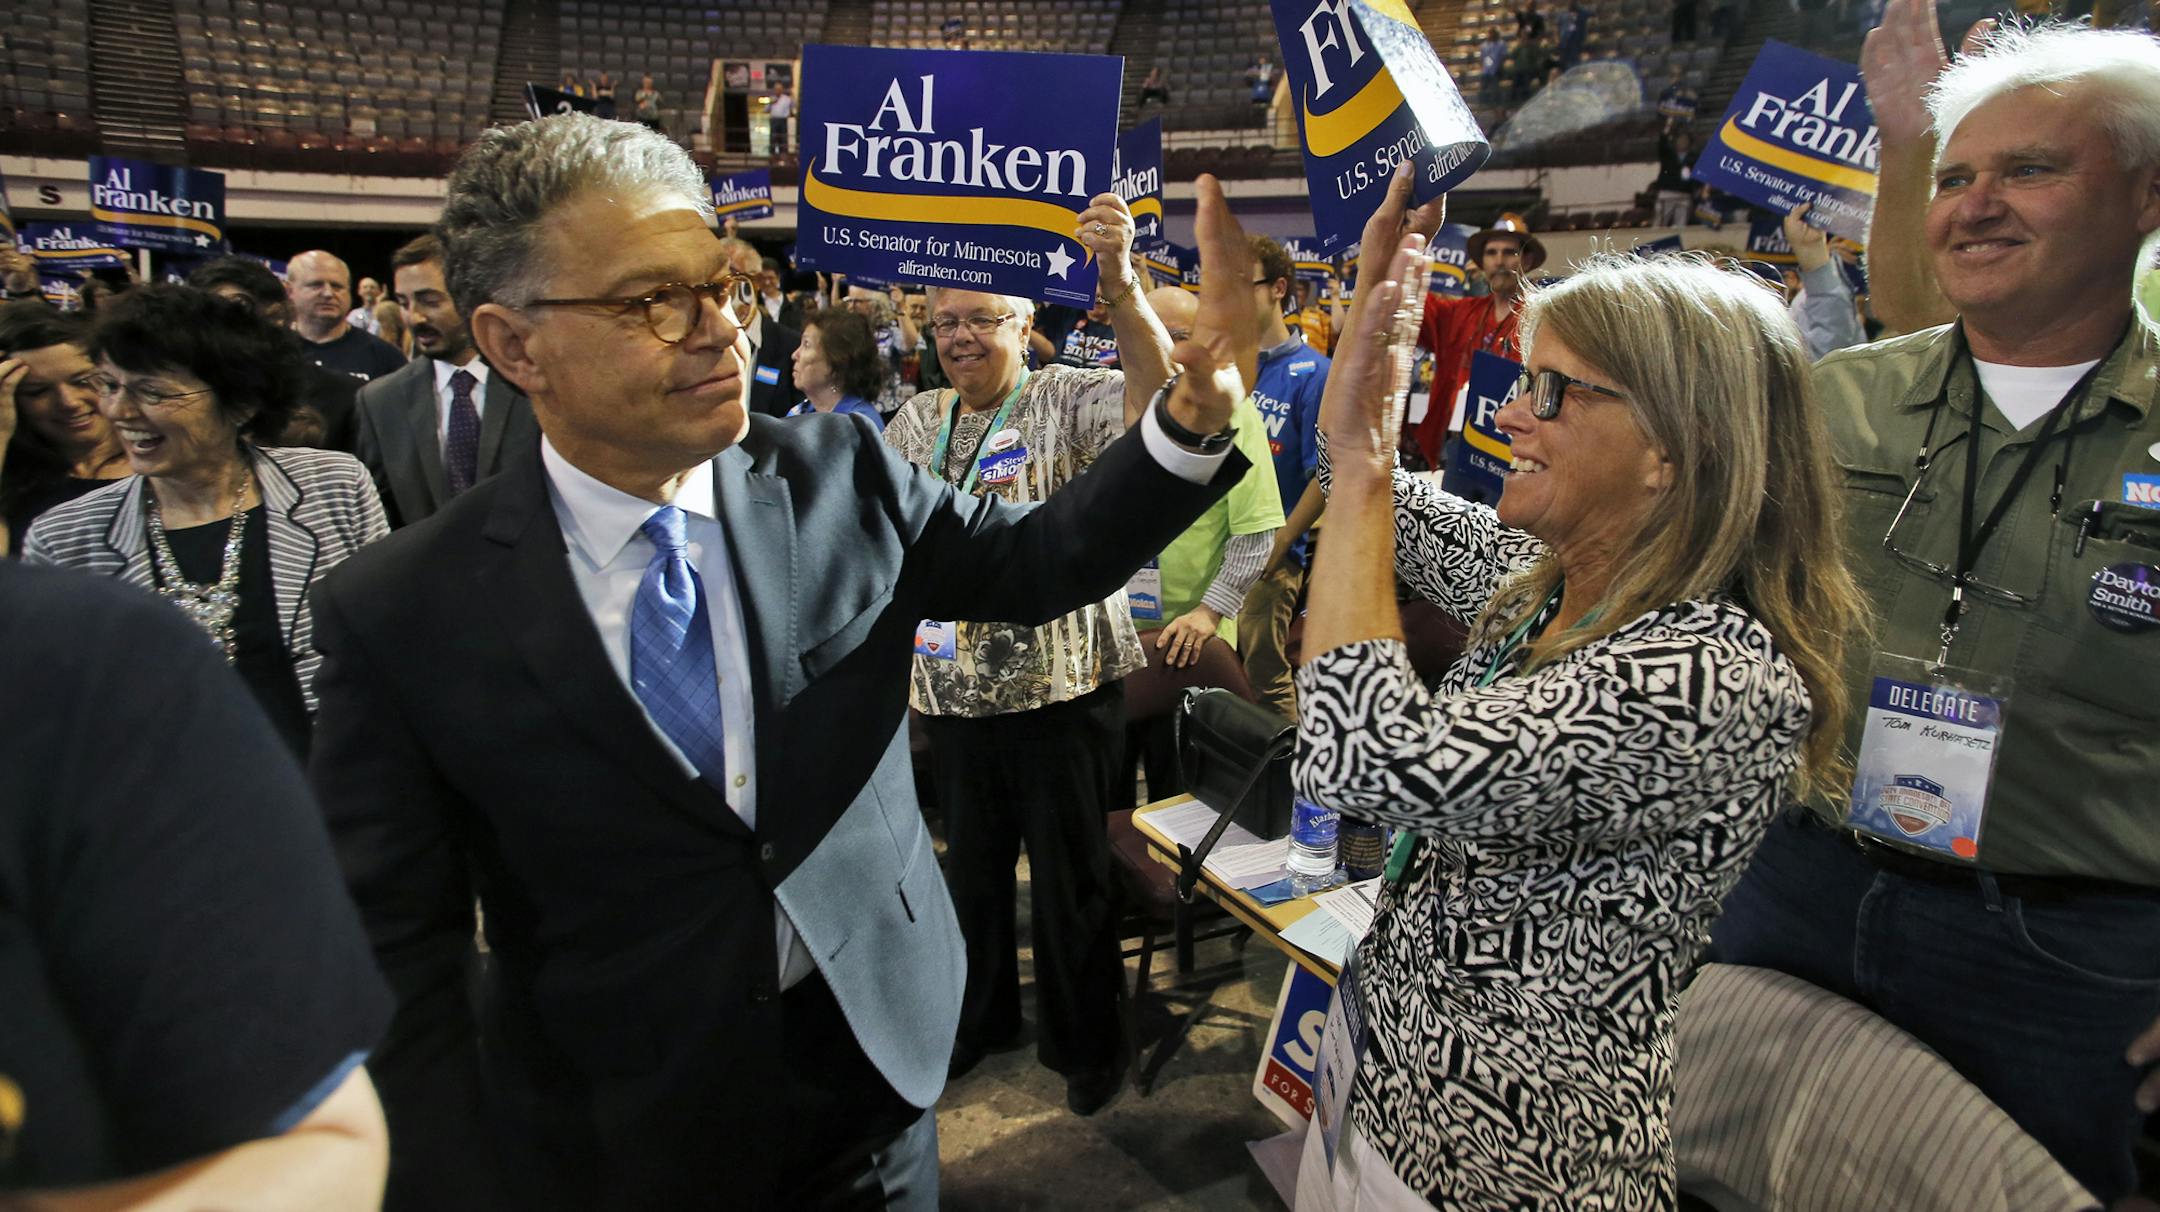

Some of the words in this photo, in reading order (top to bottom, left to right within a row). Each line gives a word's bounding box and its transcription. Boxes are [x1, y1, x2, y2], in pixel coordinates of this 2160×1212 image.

[868, 74, 935, 134] Al
[1789, 77, 1859, 123] Al
[821, 122, 1088, 198] Franken
[105, 167, 131, 191] Al
[721, 178, 734, 194] Al
[1336, 160, 1374, 200] U.S.
[1719, 155, 1743, 177] U.S.
[1744, 165, 1796, 195] Senator
[1796, 184, 1817, 202] for
[38, 185, 63, 205] S
[93, 184, 215, 220] Franken
[715, 185, 768, 206] Franken
[823, 226, 854, 247] U.S.
[858, 229, 922, 254] Senator
[926, 236, 949, 258] for
[953, 240, 1042, 268] Minnesota
[897, 258, 993, 286] alfranken.com
[1250, 390, 1292, 416] Steve
[1260, 412, 1287, 438] N
[1470, 453, 1487, 470] U.S.
[2093, 587, 2152, 614] Smith
[1889, 685, 1980, 722] DELEGATE
[1271, 1074, 1299, 1103] FOR
